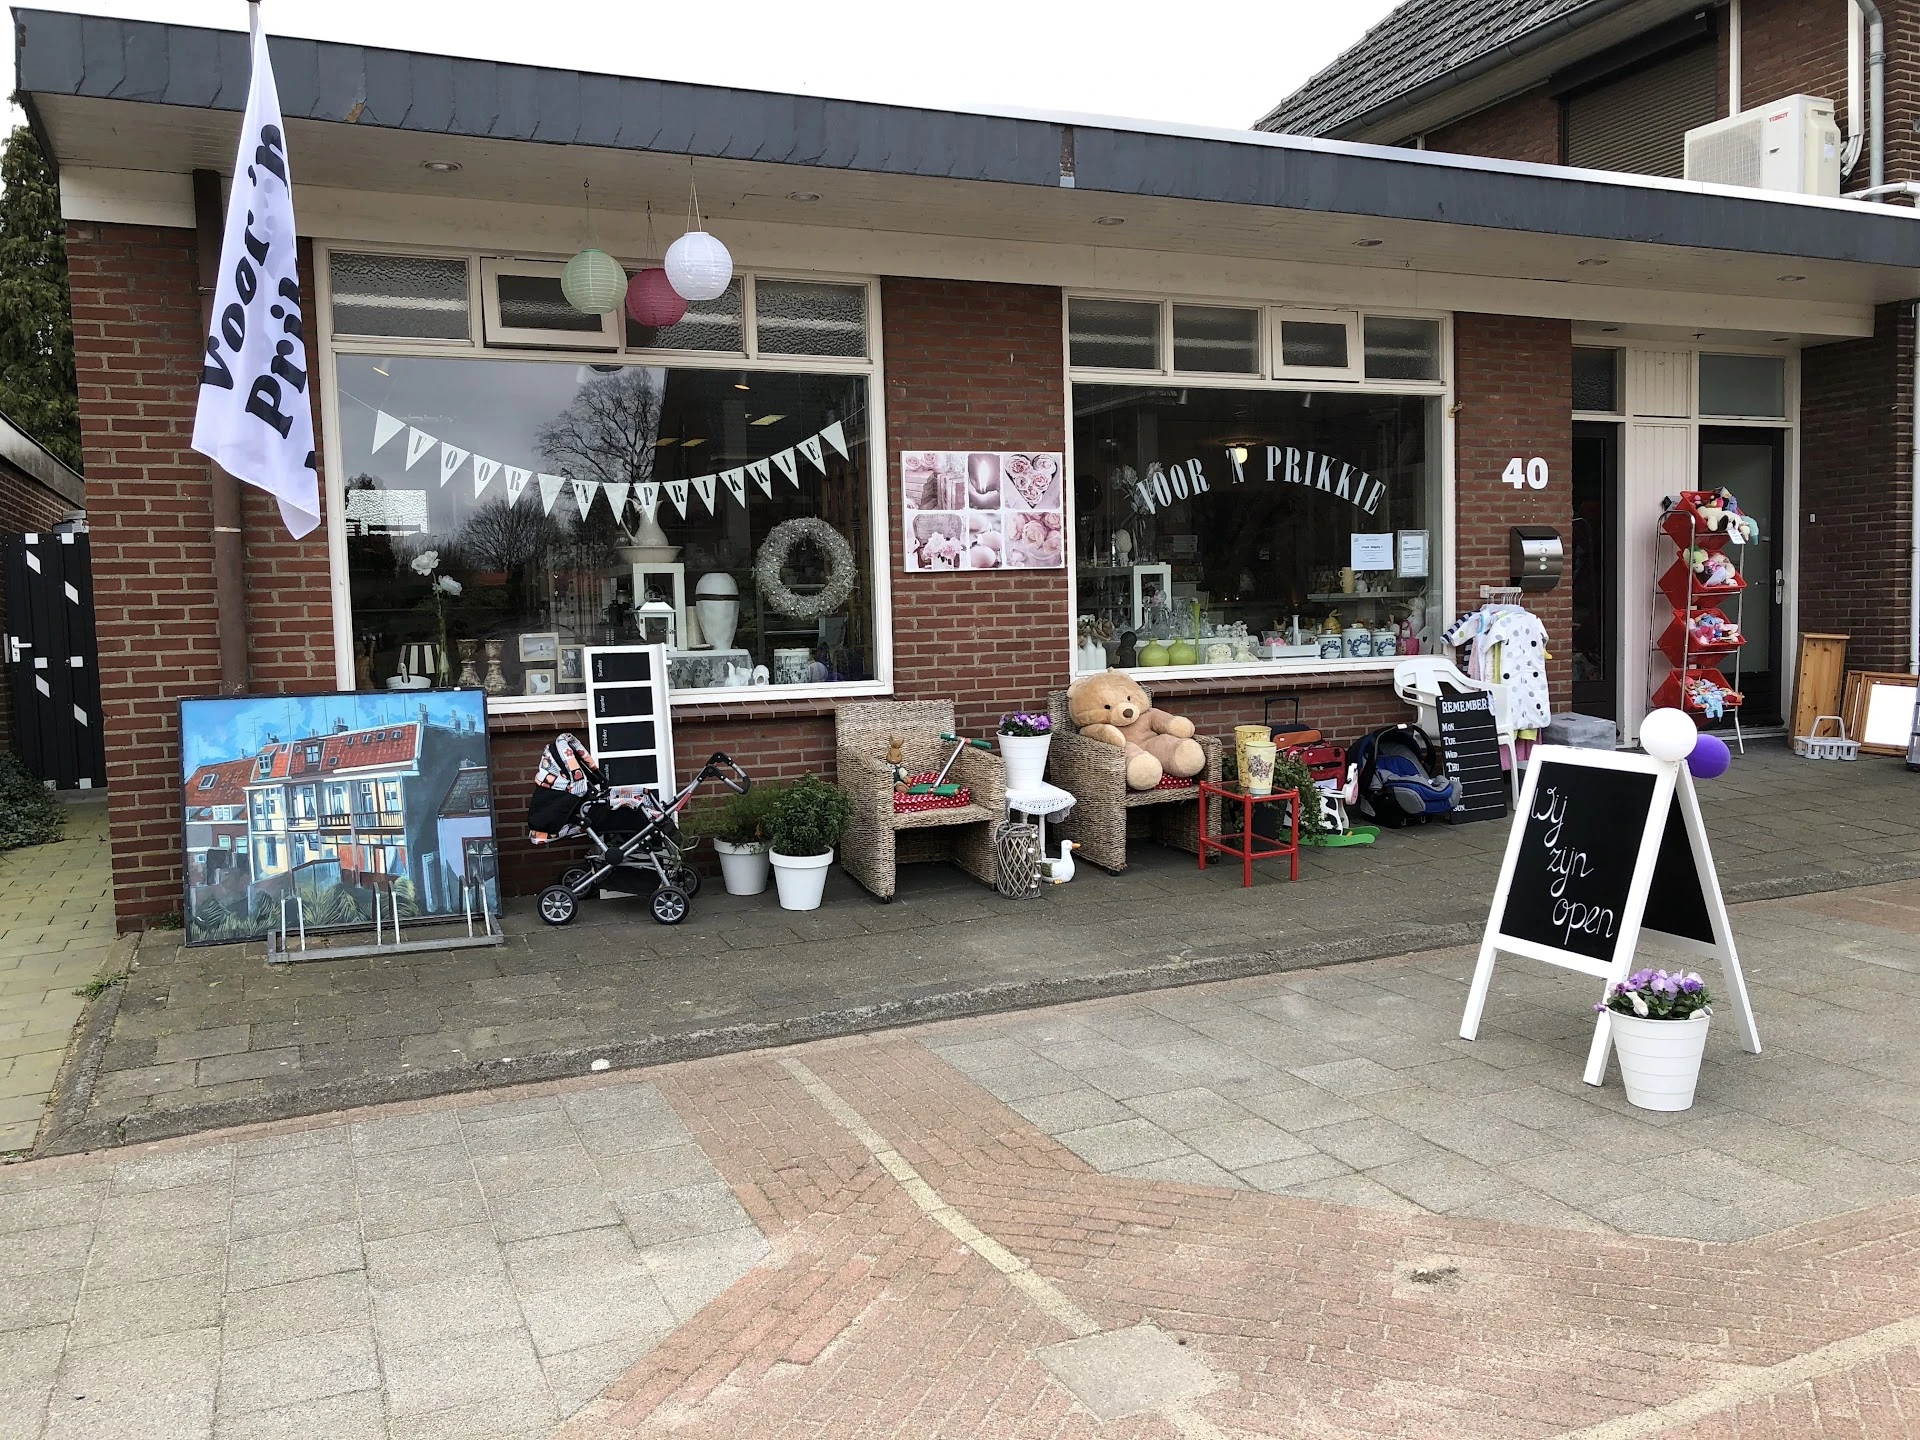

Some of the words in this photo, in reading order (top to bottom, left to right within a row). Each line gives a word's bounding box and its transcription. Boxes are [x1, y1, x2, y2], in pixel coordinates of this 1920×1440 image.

[201, 209, 270, 390] Voor
[413, 435, 522, 492] VOOR
[643, 441, 822, 506] PRIKKIE
[1135, 457, 1211, 516] VOOR
[1225, 447, 1246, 485] 'N
[1265, 445, 1387, 516] PRIKKIE
[1502, 457, 1549, 490] 40
[1441, 698, 1488, 714] REMEMBER
[1531, 786, 1568, 848] Wij
[1552, 899, 1614, 945] open
